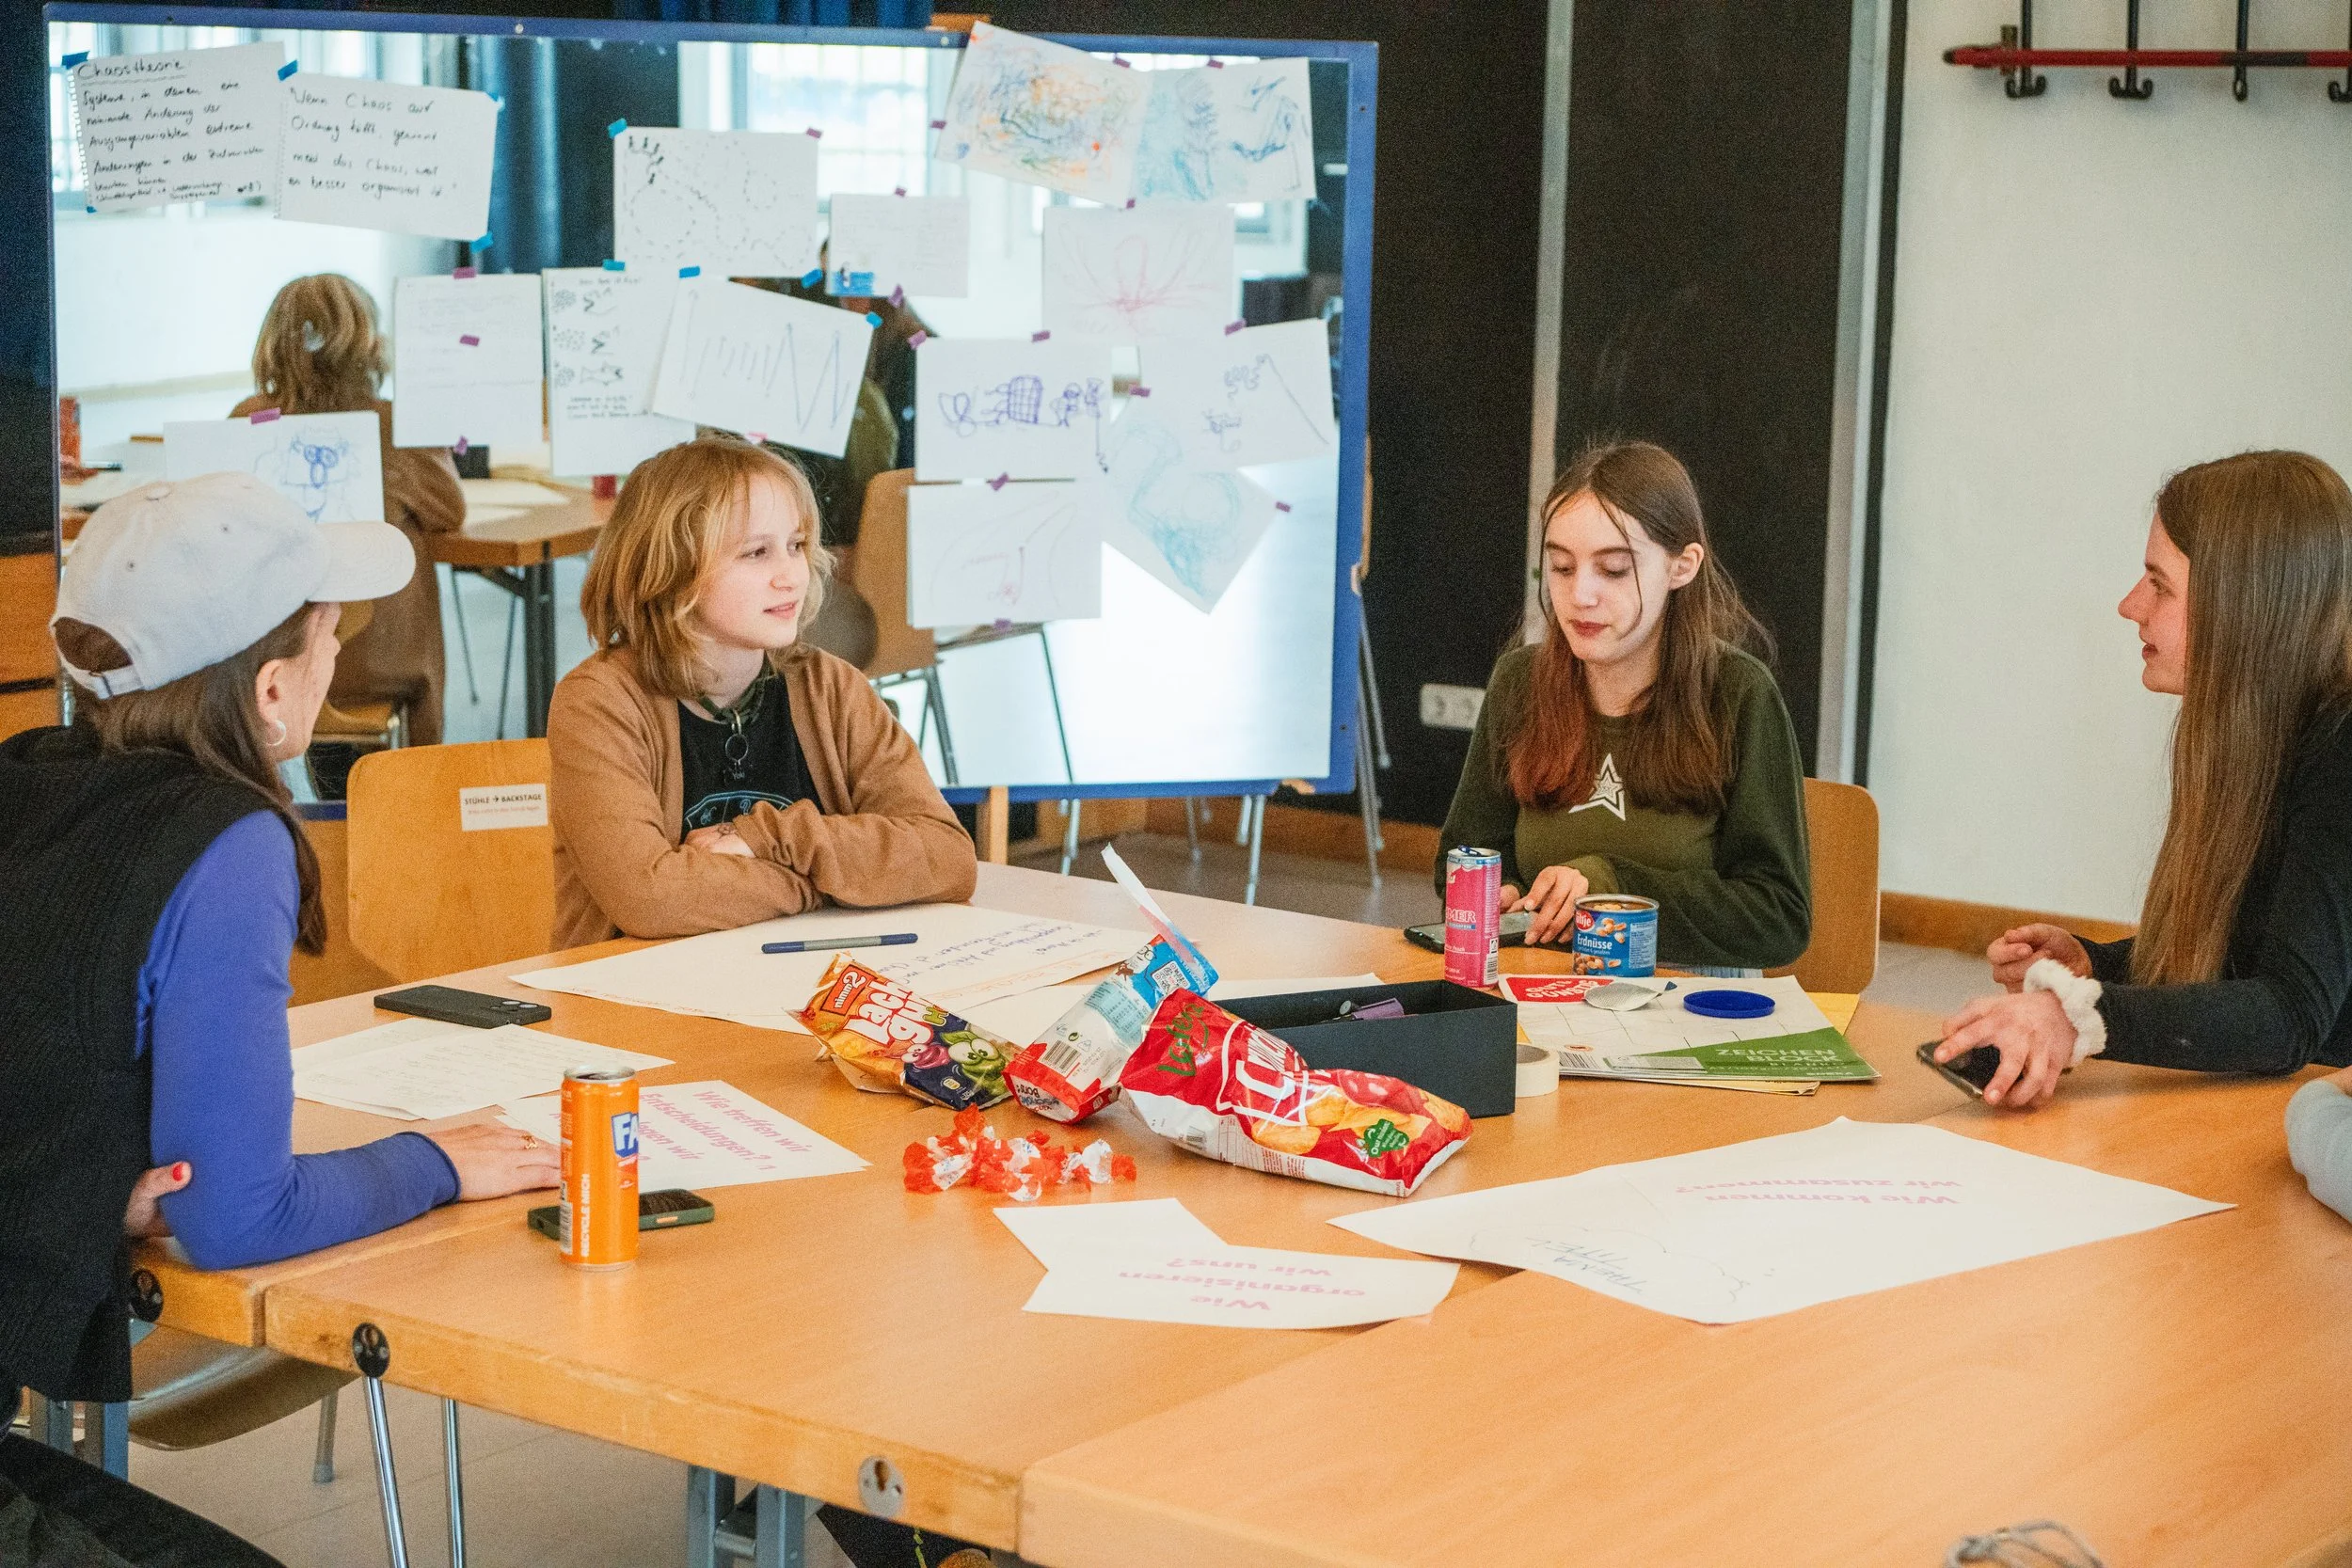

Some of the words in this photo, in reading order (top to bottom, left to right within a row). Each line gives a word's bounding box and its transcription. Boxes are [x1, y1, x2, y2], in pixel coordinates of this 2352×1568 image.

[345, 93, 391, 111] Chaos
[408, 101, 434, 114] auf
[291, 115, 341, 142] Ordnung
[311, 175, 345, 189] besser
[465, 795, 490, 805] STÜHLE
[501, 793, 542, 802] BACKSTAGE
[1577, 933, 1613, 950] Erdnüsse
[1156, 1003, 1206, 1077] Lorenz
[641, 1093, 772, 1160] Entscheidungen?
[692, 1091, 731, 1110] Wie
[724, 1109, 782, 1138] treffen
[775, 1138, 814, 1153] wir
[668, 1144, 705, 1160] wir
[581, 1173, 591, 1205] MICH
[1676, 1179, 1894, 1193] zusammen?
[1904, 1180, 1963, 1189] wir
[1705, 1194, 1872, 1204] kommen
[1881, 1195, 1962, 1205] Wie
[580, 1205, 591, 1258] RECYCLE
[1166, 1258, 1259, 1270] uns?
[1268, 1266, 1332, 1276] wir
[1118, 1272, 1366, 1297] organisieren
[1190, 1294, 1271, 1311] Wie
